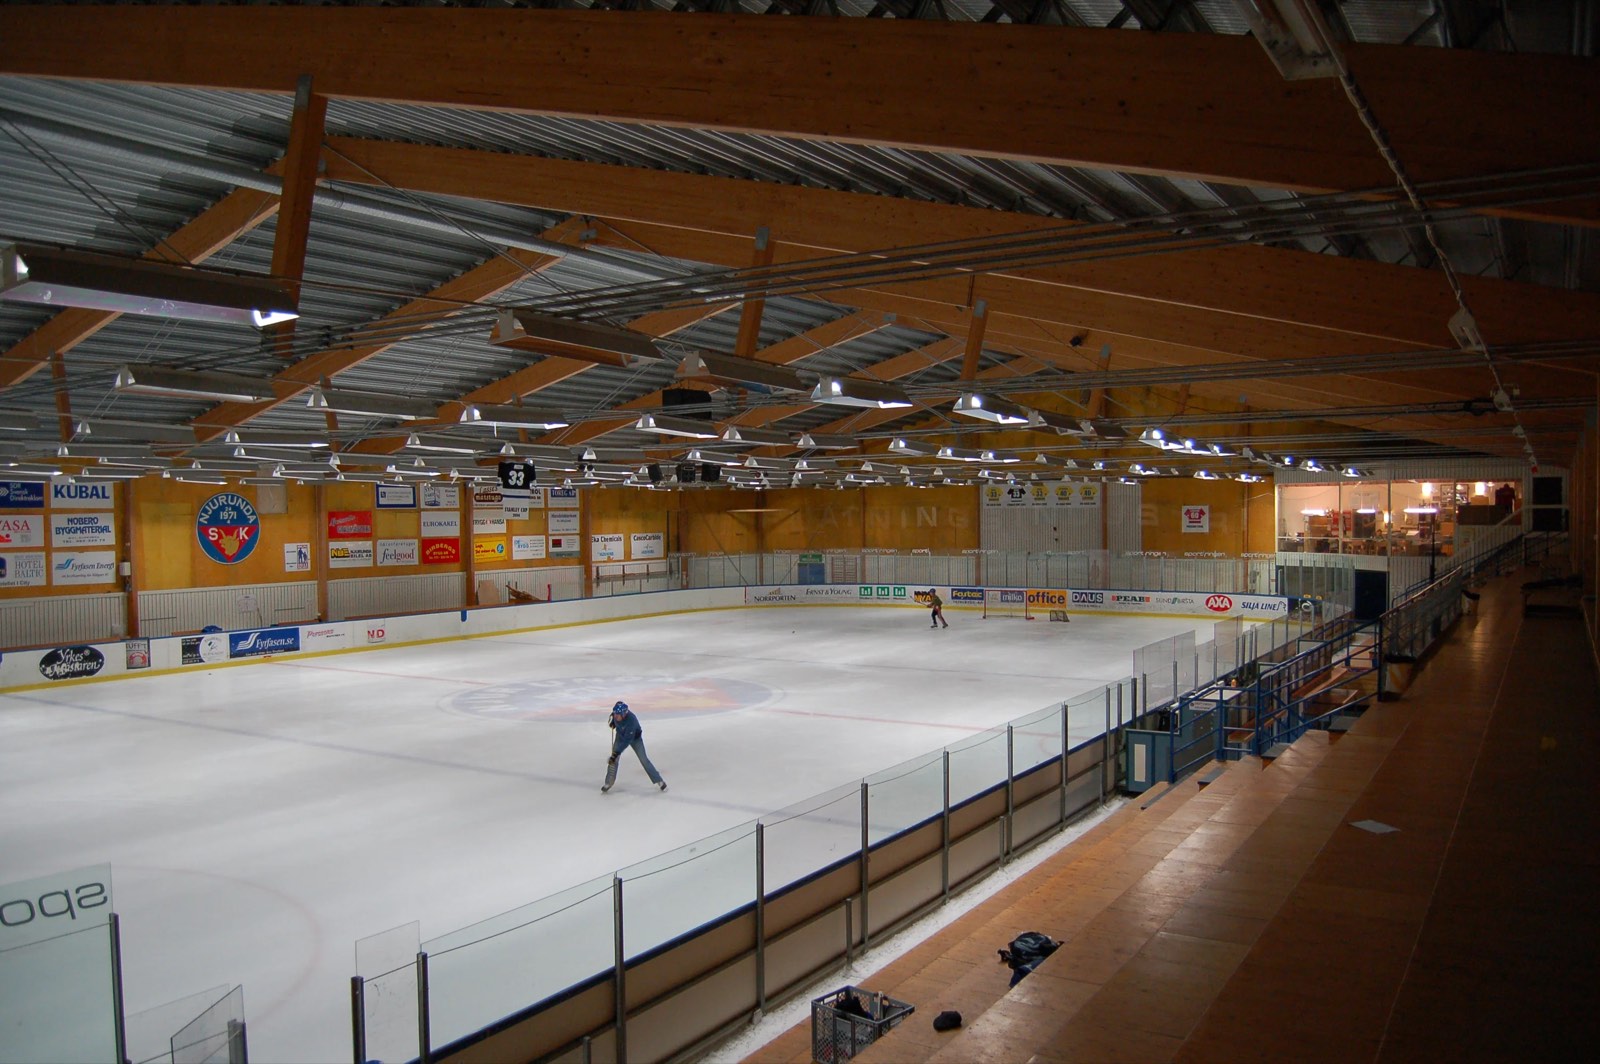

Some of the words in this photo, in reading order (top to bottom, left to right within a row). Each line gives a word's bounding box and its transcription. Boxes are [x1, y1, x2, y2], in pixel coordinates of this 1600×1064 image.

[508, 470, 525, 487] 33
[54, 485, 110, 499] KUBAL
[199, 495, 257, 524] NJURUNDA
[67, 517, 99, 525] NOBERO
[220, 512, 237, 520] 1971
[0, 520, 30, 531] ASA
[55, 525, 111, 535] BYGGMATERIAL
[208, 527, 219, 540] S
[239, 527, 249, 540] K
[380, 548, 415, 564] feelgood
[15, 560, 43, 570] HOTEL
[71, 562, 96, 571] Fyrfasen
[96, 562, 115, 570] Energi
[15, 569, 44, 578] BALTIC
[1028, 591, 1066, 604] office
[1073, 593, 1103, 602] DAUS
[1208, 597, 1231, 608] AXA
[1241, 601, 1258, 610] SILJA
[1260, 603, 1278, 611] LINE
[255, 637, 295, 649] Fyrfasen.se
[57, 649, 84, 664] Yrkes
